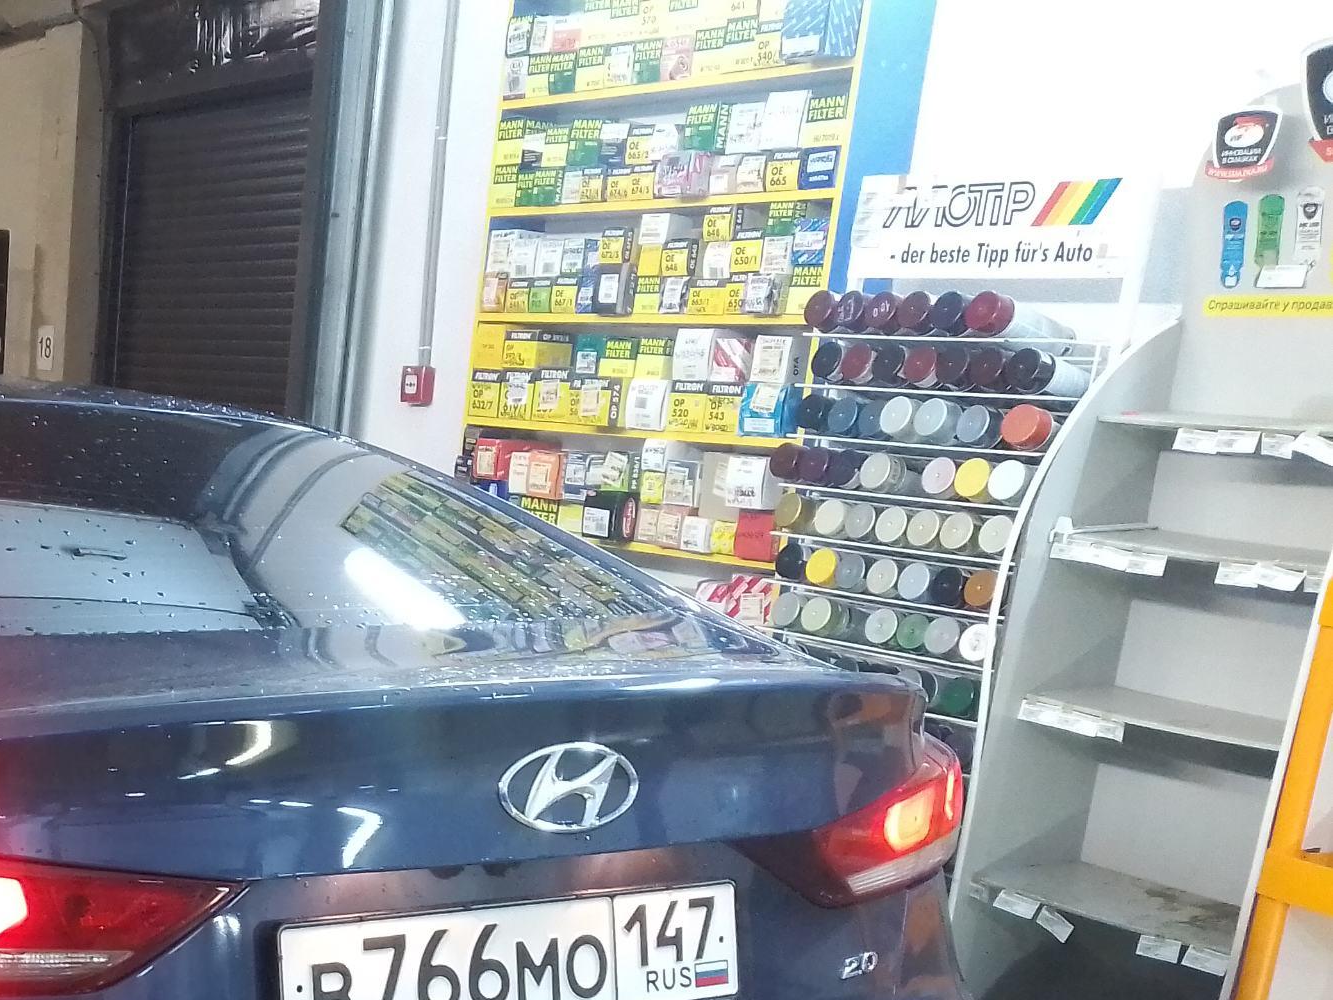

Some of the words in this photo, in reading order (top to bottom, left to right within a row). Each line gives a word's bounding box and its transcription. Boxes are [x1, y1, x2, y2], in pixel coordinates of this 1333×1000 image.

[728, 18, 758, 31] MANN
[697, 29, 724, 40] MANN
[636, 40, 663, 51] MANN
[696, 39, 723, 50] FILTER
[579, 47, 604, 57] MANN
[635, 50, 661, 61] FILTER
[578, 56, 603, 67] FILTER
[810, 96, 845, 109] MANN
[689, 104, 717, 114] MANN
[808, 107, 844, 121] FILTER
[573, 119, 602, 129] MANN
[687, 113, 715, 125] FILTER
[499, 120, 524, 130] MANN
[498, 129, 523, 139] FILTER
[571, 128, 600, 139] FILTER
[496, 166, 517, 175] MANN
[535, 169, 556, 178] MANN
[771, 167, 783, 176] OE
[494, 174, 517, 183] FILTER
[534, 176, 555, 186] FILTER
[770, 202, 794, 210] MANN
[769, 209, 793, 217] FILTER
[736, 246, 746, 255] OE
[901, 243, 926, 264] der
[929, 242, 971, 264] beste
[976, 242, 1009, 269] Tipp
[1015, 240, 1049, 263] für's
[1054, 240, 1093, 263] Auto
[638, 277, 660, 286] MANN
[637, 285, 659, 293] FILTER
[1208, 299, 1280, 311] Спрашивайте
[38, 336, 52, 359] 18
[607, 341, 631, 349] MANN
[641, 338, 665, 347] MANN
[606, 349, 630, 358] FILTER
[640, 346, 663, 354] FILTER
[475, 372, 499, 380] FILTRON
[541, 370, 569, 379] FILTRON
[675, 382, 703, 391] FILTRON
[712, 384, 742, 394] FILTRON
[473, 390, 483, 398] OP
[673, 398, 685, 407] OP
[711, 401, 722, 410] OP
[672, 408, 688, 417] 520
[709, 412, 725, 421] 543
[521, 497, 557, 512] MANN
[624, 896, 715, 967] 147
[646, 966, 693, 993] RUS
